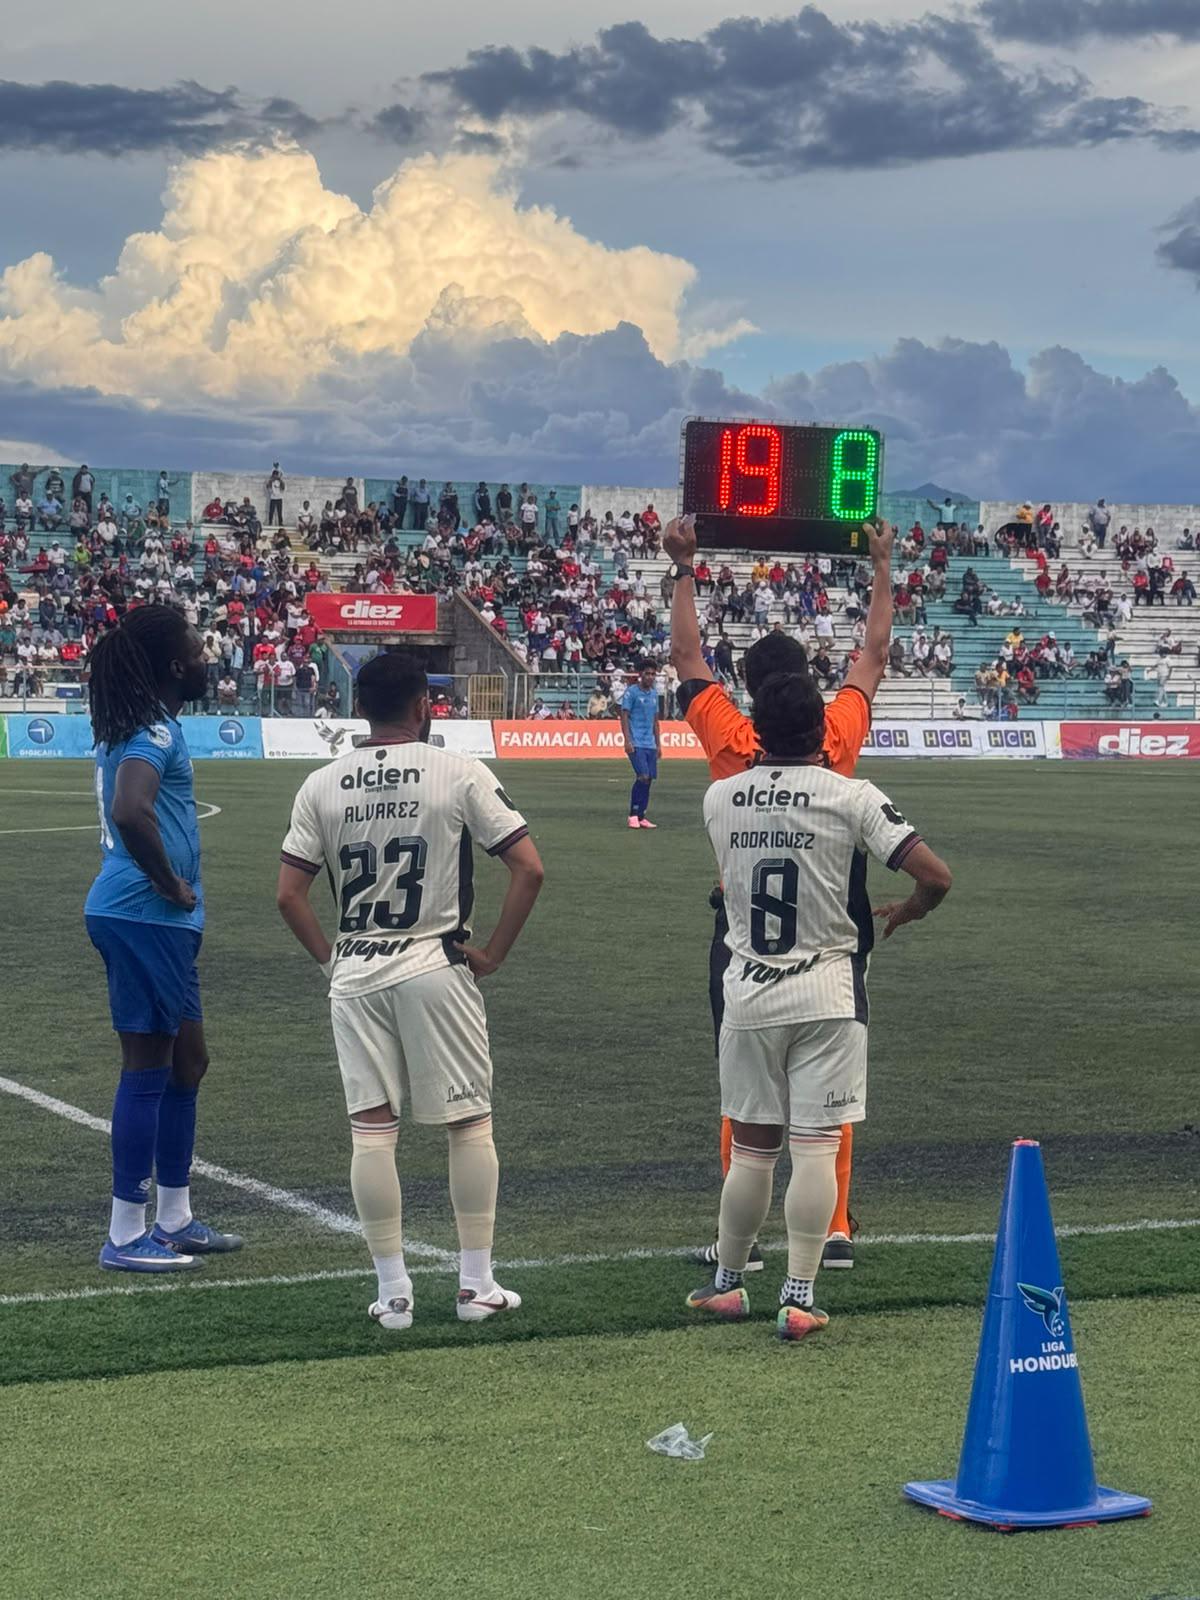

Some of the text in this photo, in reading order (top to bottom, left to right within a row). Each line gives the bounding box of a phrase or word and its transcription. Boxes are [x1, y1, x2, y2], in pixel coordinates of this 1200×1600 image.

[720, 426, 876, 519] 19 8
[340, 600, 403, 619] diez
[501, 732, 592, 747] FARMACIA
[597, 732, 625, 747] MO
[924, 730, 972, 747] HCH
[988, 730, 1036, 747] HCH
[1098, 728, 1190, 756] diez
[340, 763, 420, 790] alcien
[732, 784, 810, 808] alcien
[345, 801, 420, 823] ALVAREZ
[730, 831, 816, 850] RODRIGUEZ
[339, 835, 428, 933] 23
[750, 858, 799, 955] 8
[1041, 1341, 1066, 1353] LIGA
